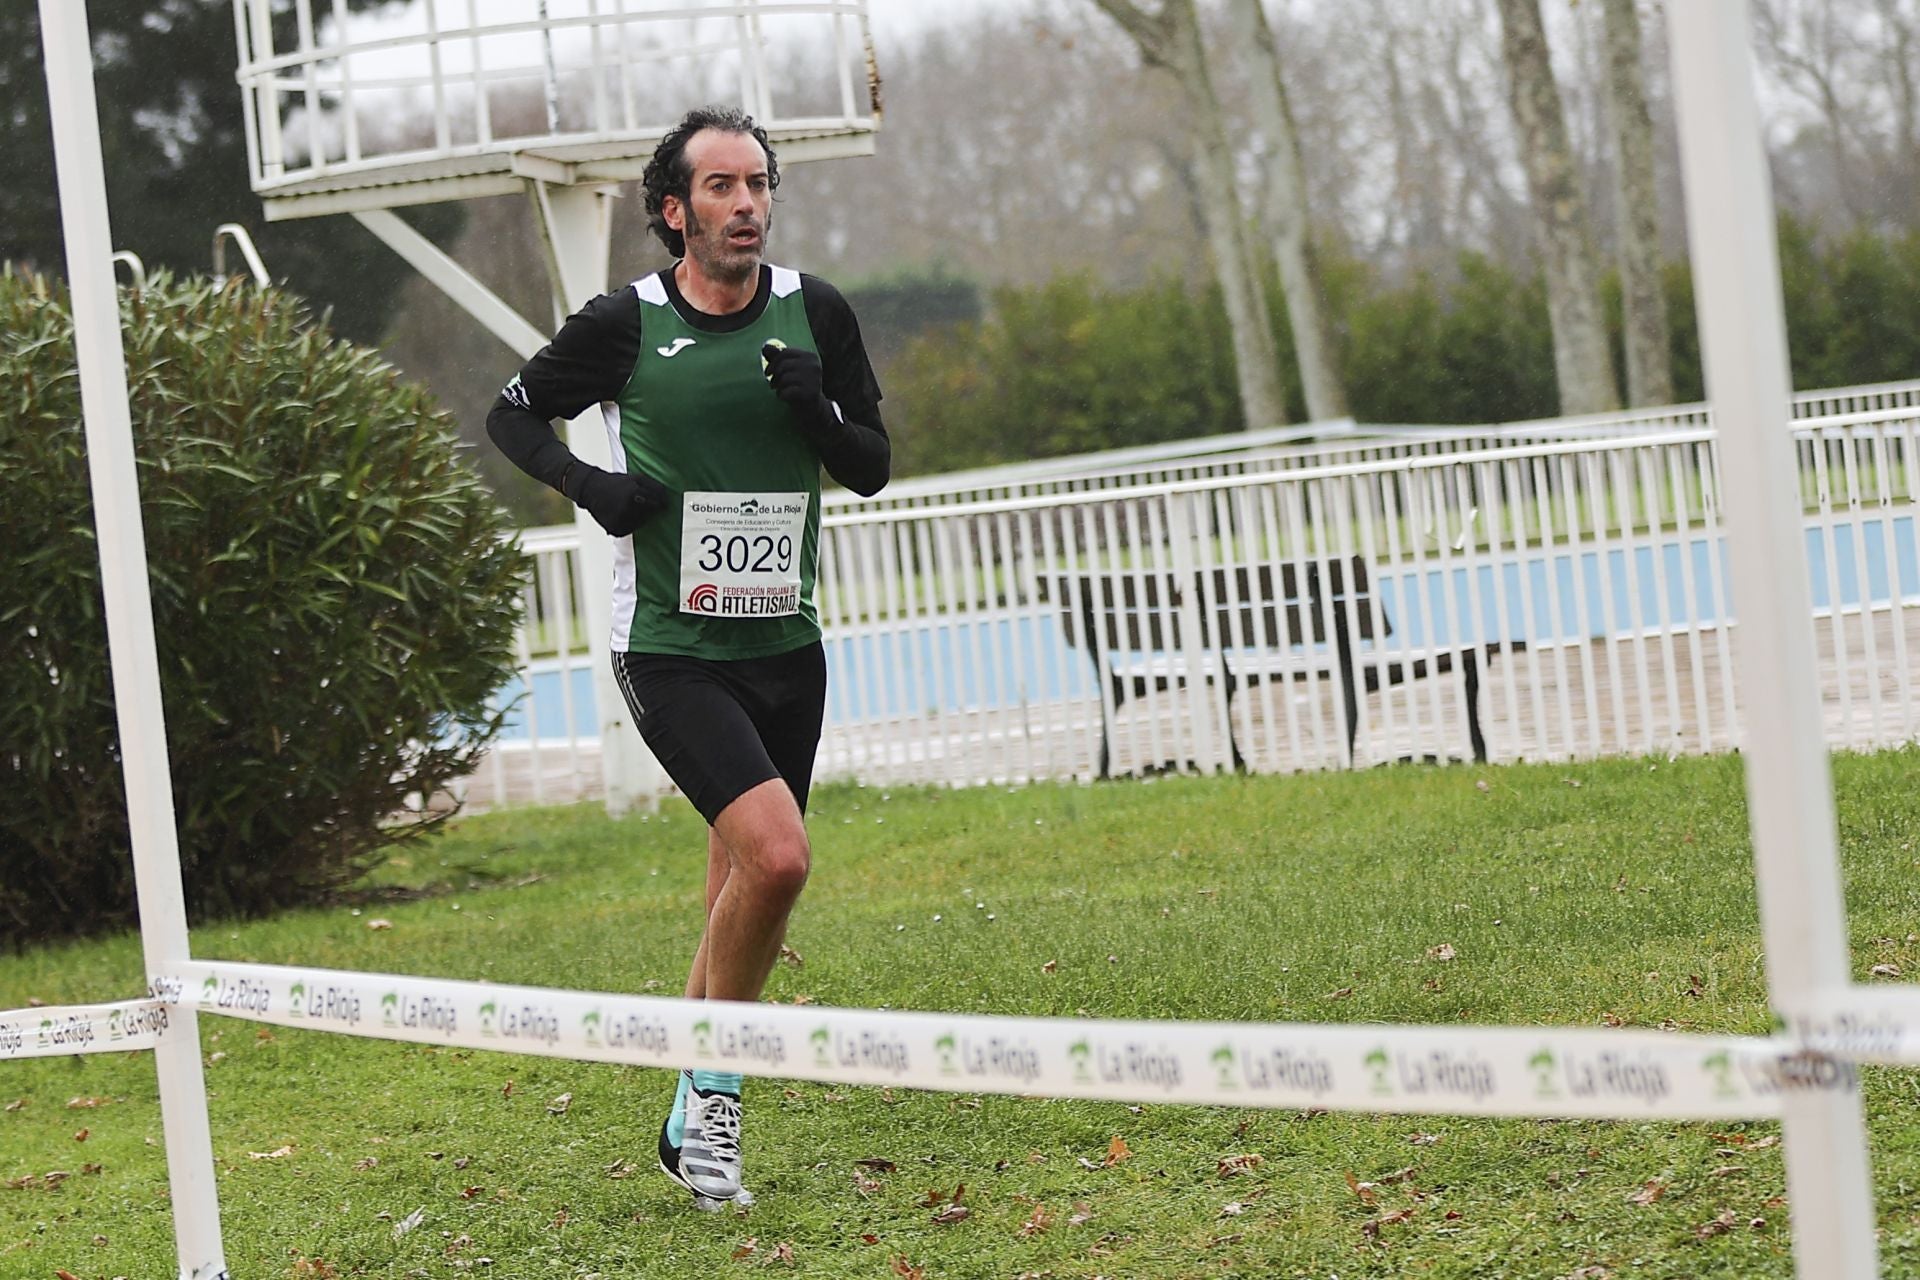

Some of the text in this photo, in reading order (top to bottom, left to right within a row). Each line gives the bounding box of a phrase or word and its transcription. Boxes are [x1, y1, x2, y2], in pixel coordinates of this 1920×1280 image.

[692, 504, 801, 515] Gobierno de La Rioja
[699, 534, 792, 573] 3029
[722, 595, 796, 614] ATLETISMO
[723, 584, 797, 597] FEDERACIÓN RIOJANA DE
[218, 979, 270, 1016] La Rioja
[308, 985, 361, 1027] La Rioja
[402, 995, 456, 1037] La Rioja
[51, 1014, 94, 1047] La Rioja
[122, 1007, 168, 1036] La Rioja
[500, 1005, 560, 1046] La Rioja
[605, 1014, 670, 1057] La Rioja
[717, 1024, 786, 1067] La Rioja
[835, 1030, 909, 1074] La Rioja
[962, 1034, 1041, 1084] La Rioja
[1097, 1041, 1183, 1092] La Rioja
[1241, 1043, 1333, 1098] La Rioja
[1397, 1048, 1496, 1101] La Rioja
[1562, 1050, 1672, 1105] La Rioja
